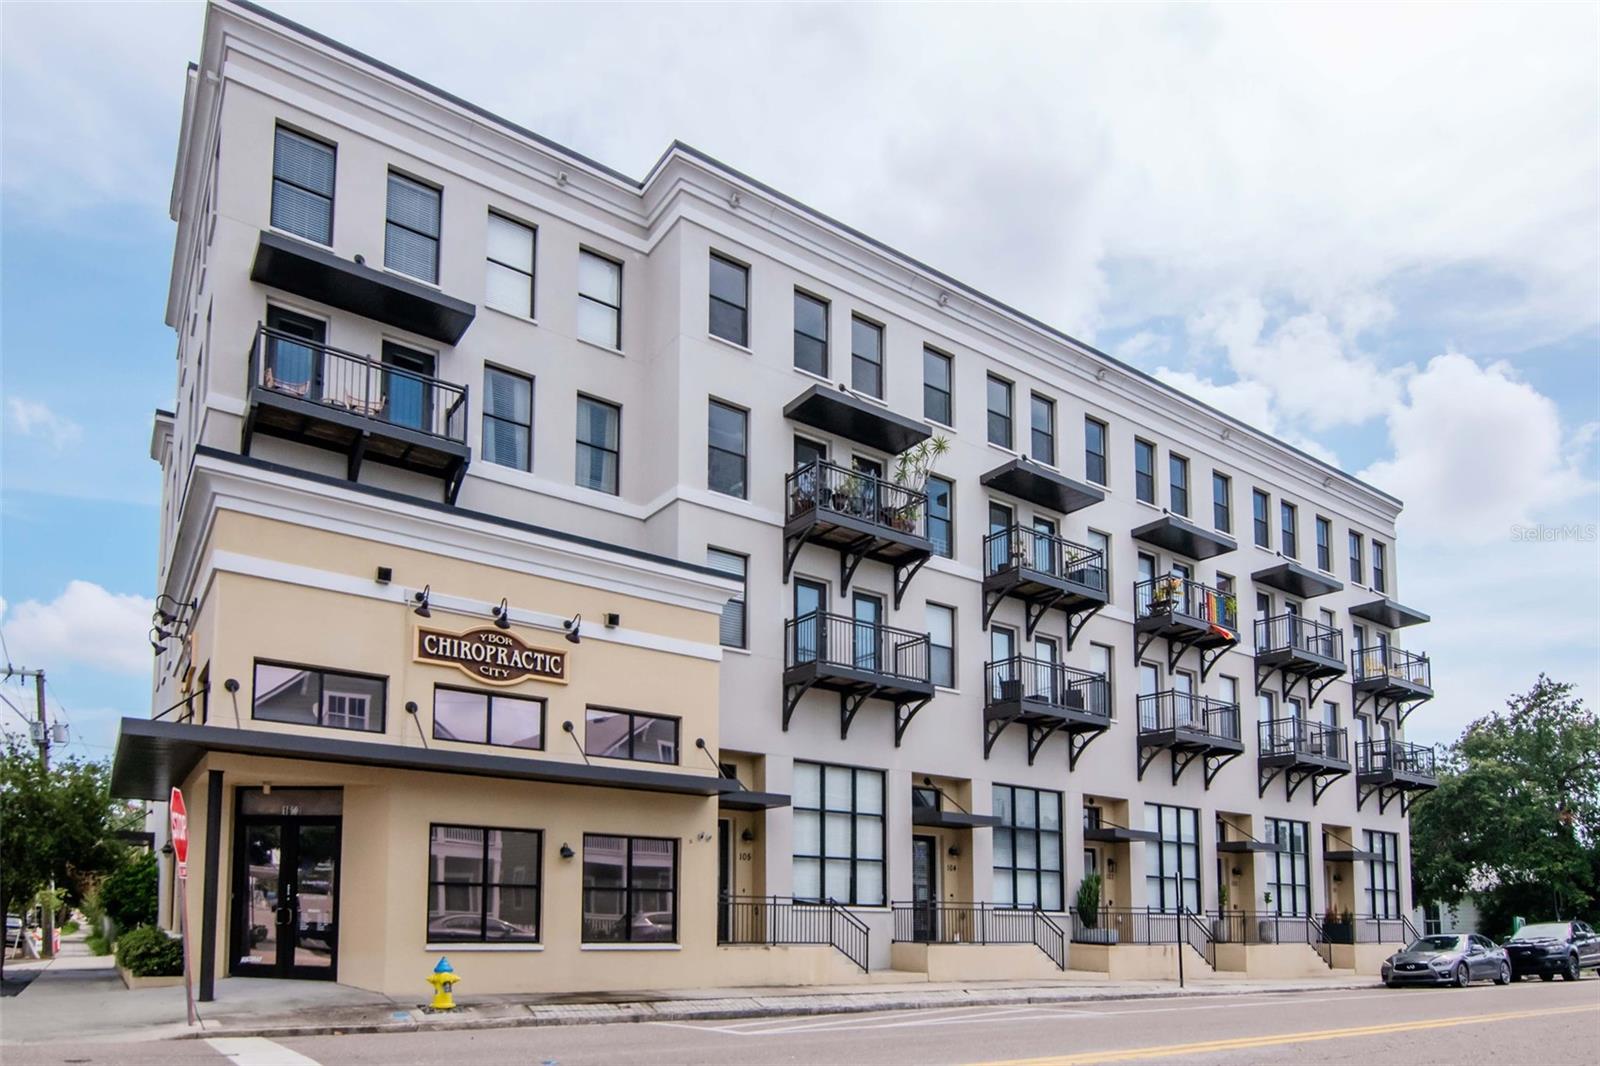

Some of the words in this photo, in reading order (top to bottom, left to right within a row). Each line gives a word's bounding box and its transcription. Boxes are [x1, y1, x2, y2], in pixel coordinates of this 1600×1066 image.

[480, 633, 513, 646] YBOR
[424, 635, 561, 674] CHIROPRACTIC
[480, 665, 510, 678] CITY
[172, 812, 187, 841] STOP
[739, 853, 752, 862] 105
